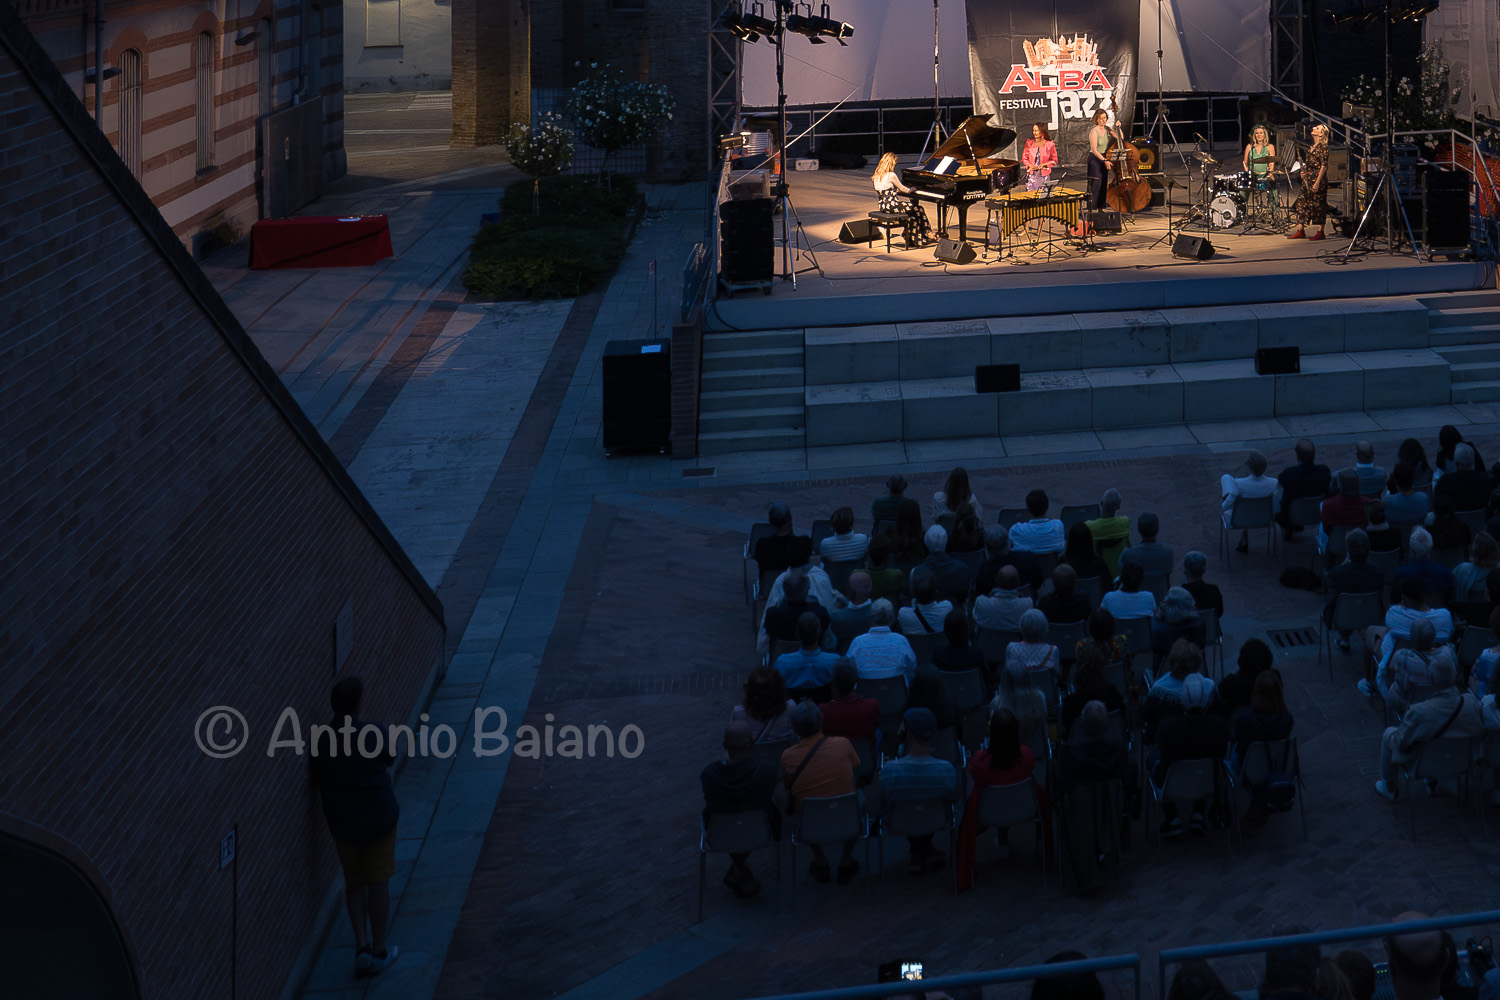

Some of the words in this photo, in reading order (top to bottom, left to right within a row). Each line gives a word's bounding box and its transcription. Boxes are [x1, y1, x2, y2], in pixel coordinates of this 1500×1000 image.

[998, 64, 1114, 94] ALBA
[999, 98, 1048, 110] FESTIVAL
[1046, 90, 1114, 131] jazz
